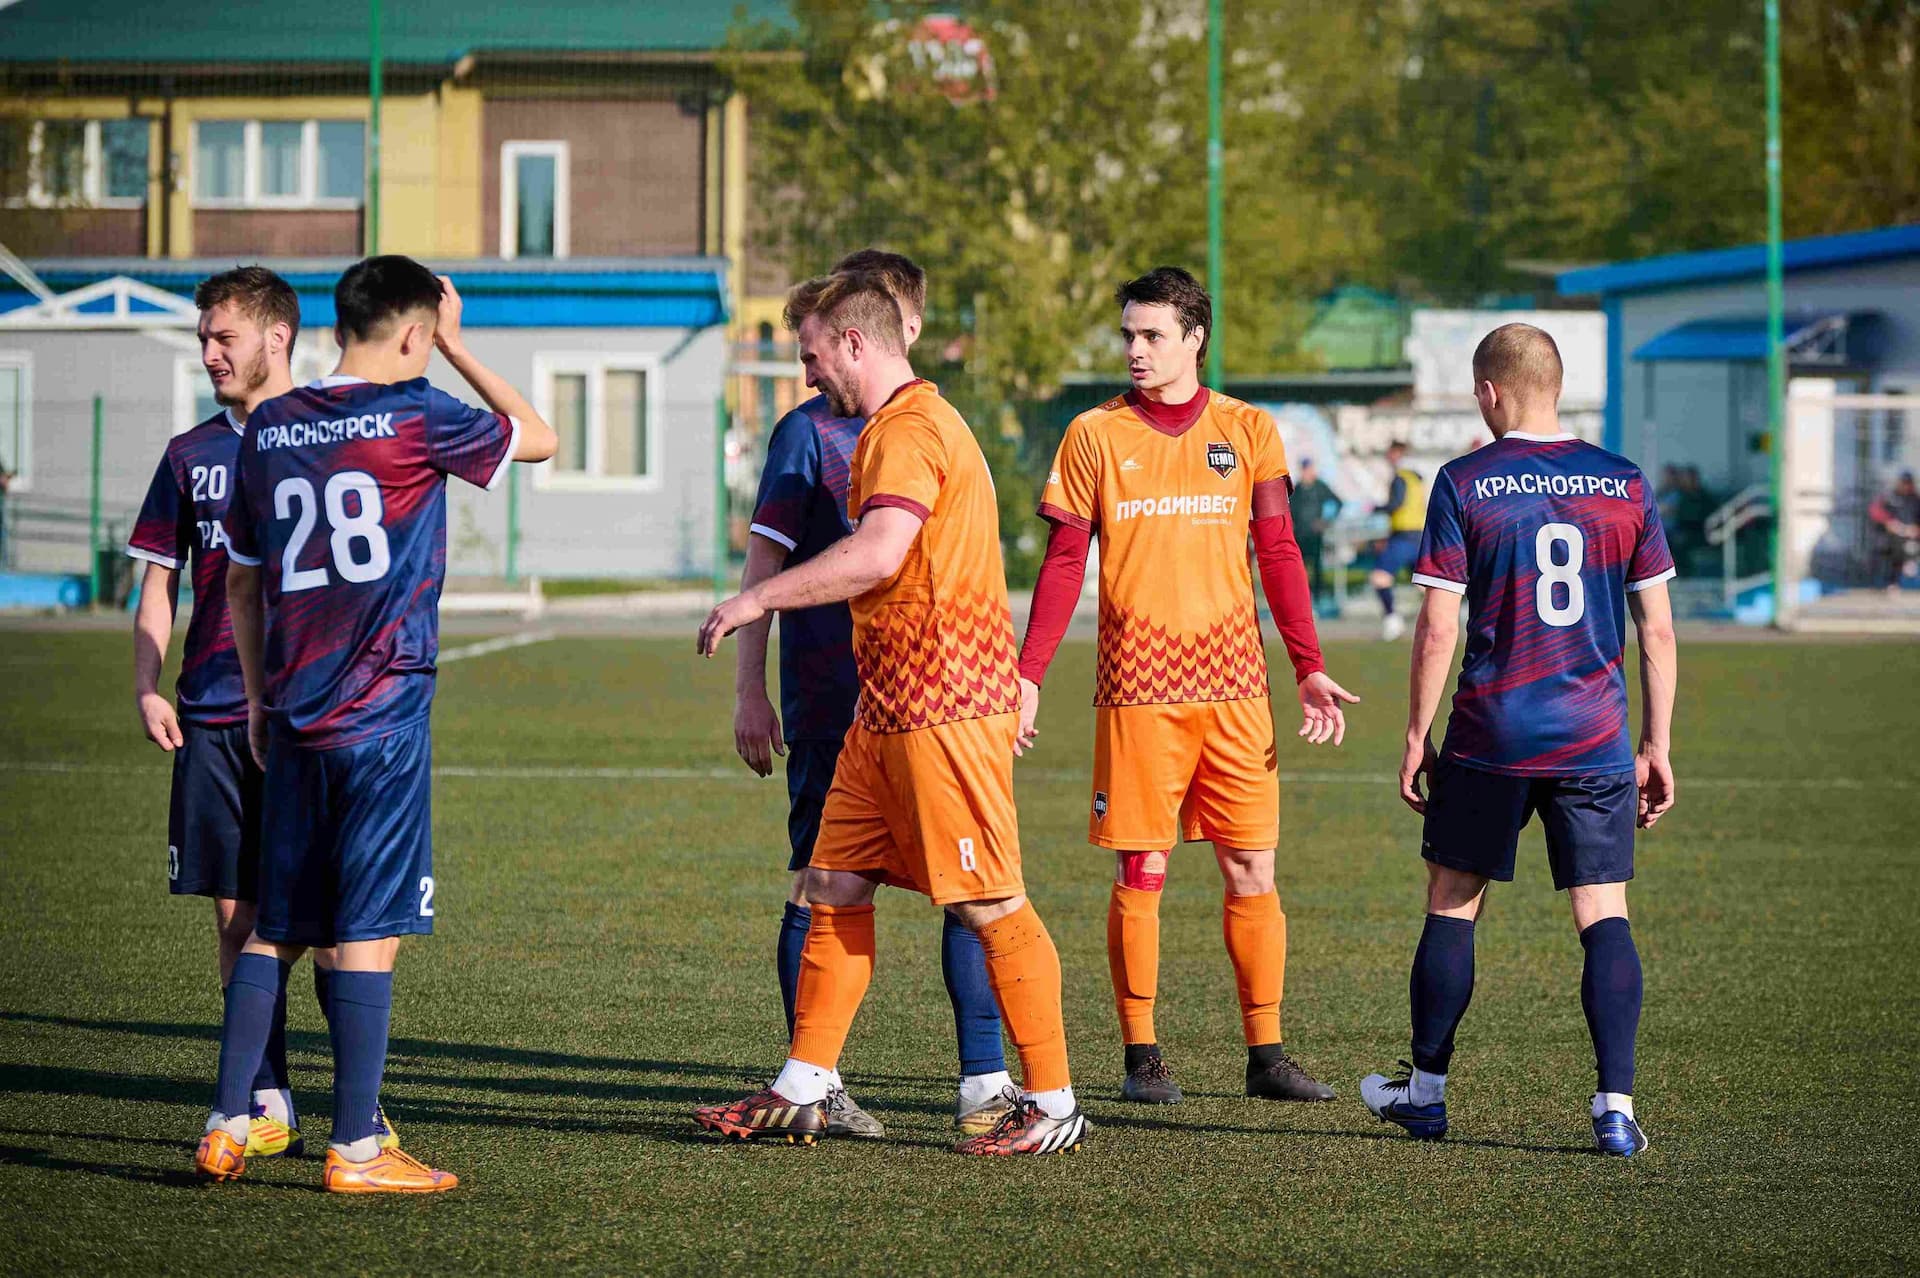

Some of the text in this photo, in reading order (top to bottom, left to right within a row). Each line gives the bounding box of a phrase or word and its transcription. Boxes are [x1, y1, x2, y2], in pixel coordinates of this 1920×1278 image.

[257, 412, 397, 451] КРАСНОЯРСК
[1209, 452, 1235, 467] ТЕМП
[191, 465, 227, 502] 20
[1474, 473, 1630, 499] КРАСНОЯРСК
[1116, 495, 1238, 522] ПРОДИНВЕСТ
[274, 470, 391, 593] 28
[1535, 522, 1585, 627] 8
[958, 837, 976, 872] 8
[418, 876, 434, 917] 2
